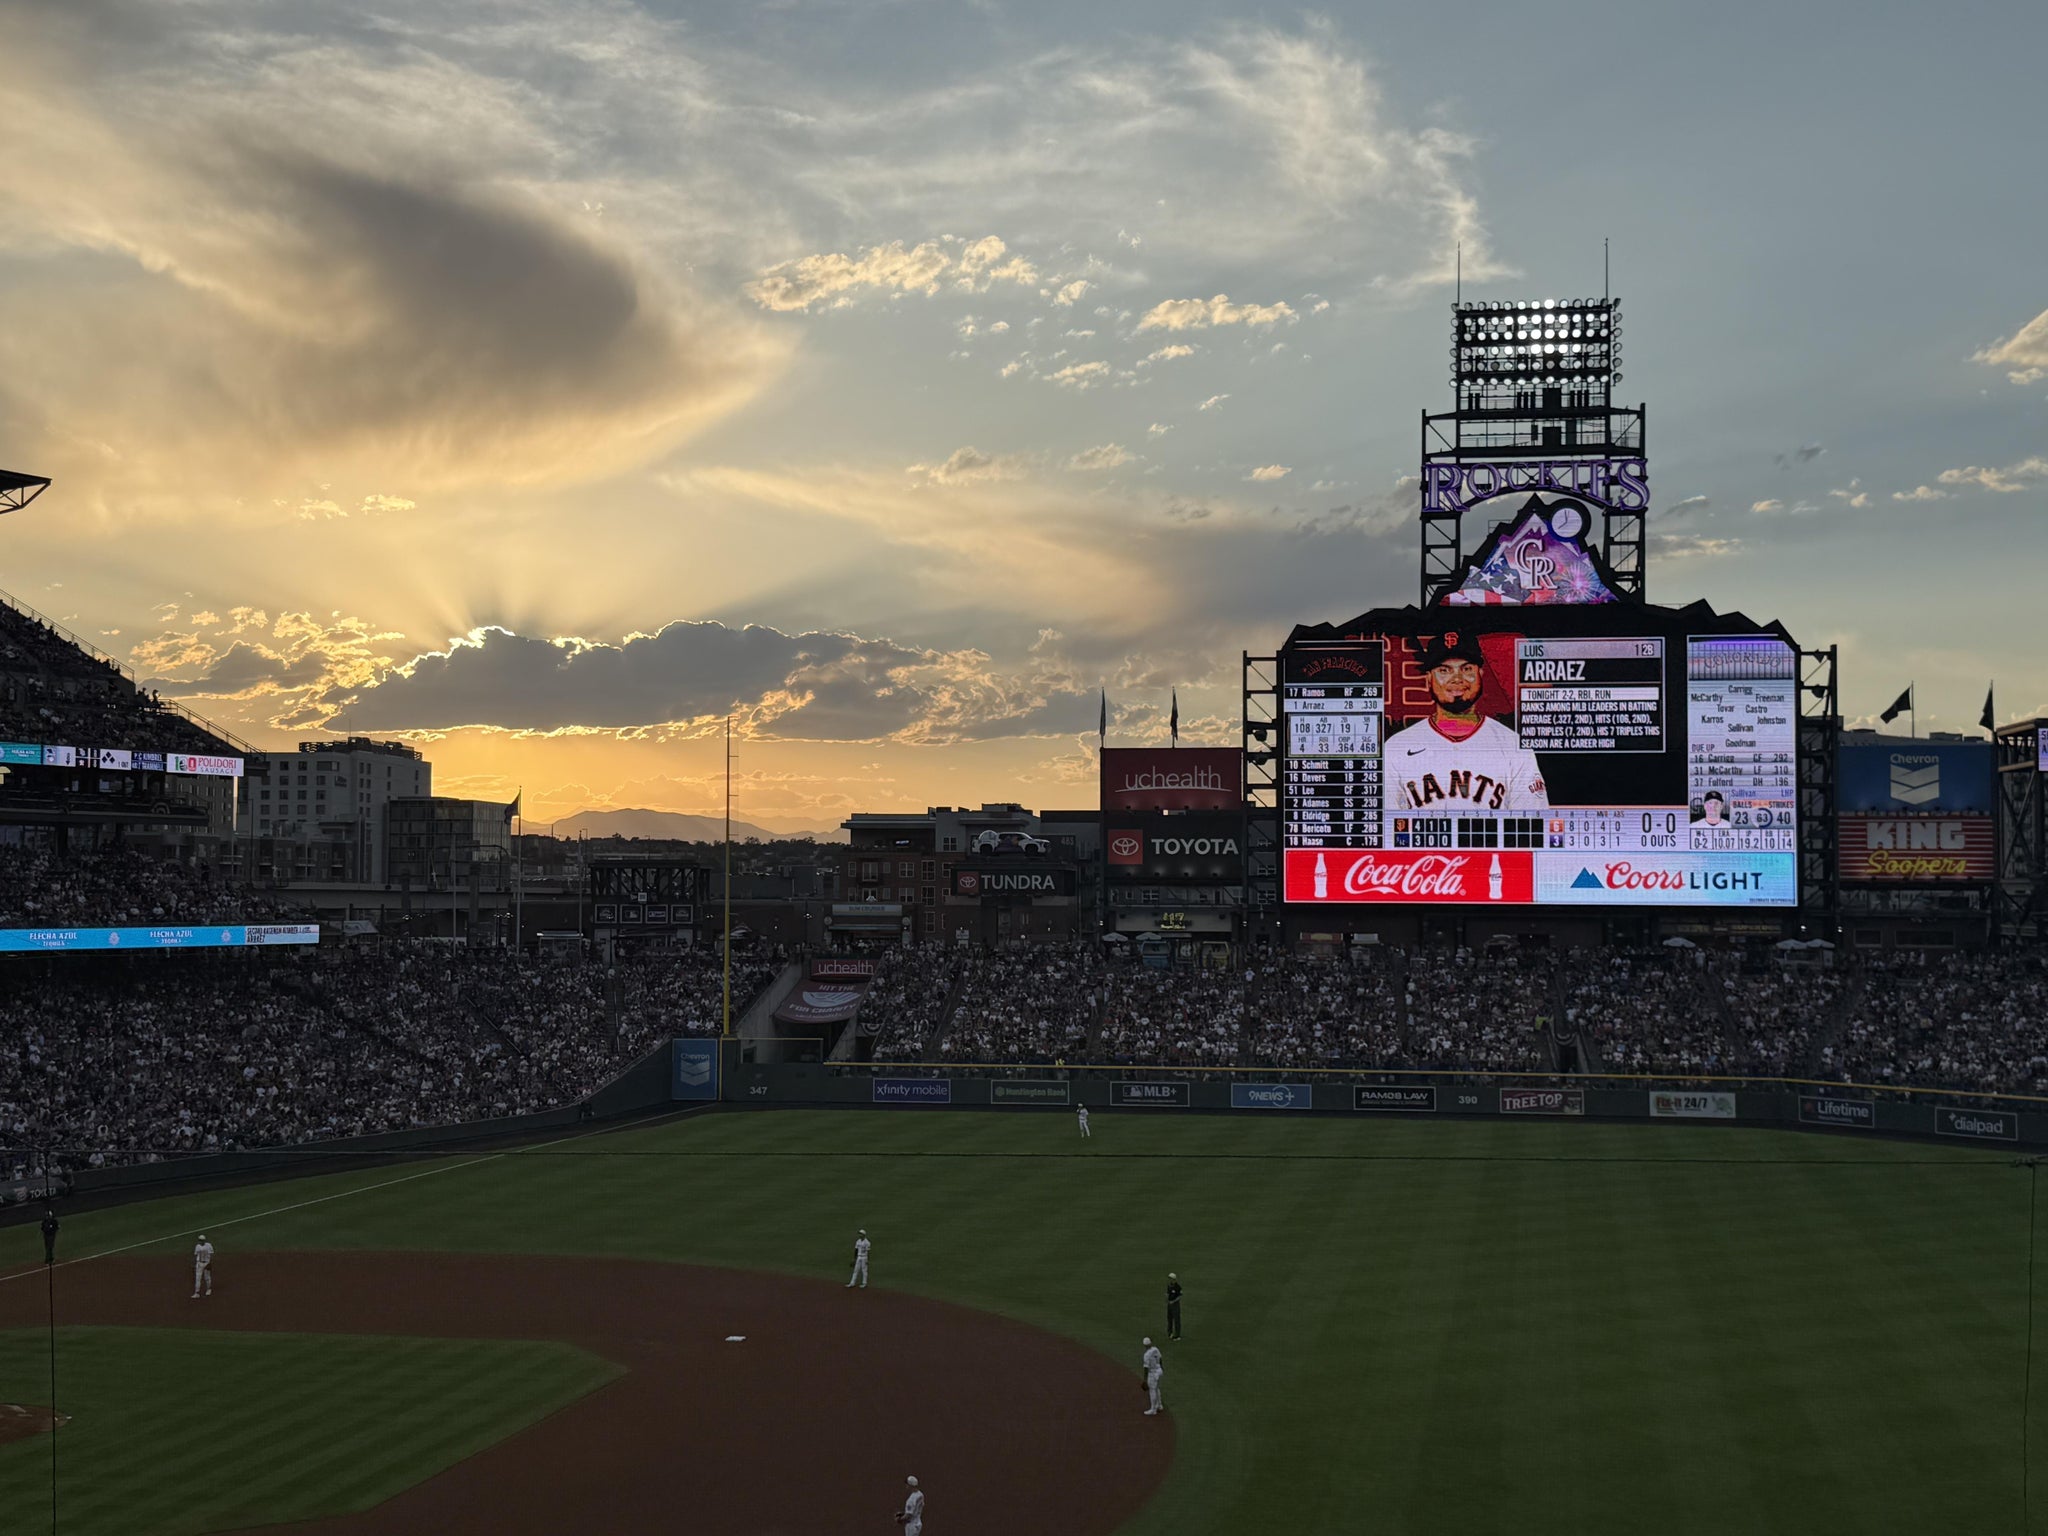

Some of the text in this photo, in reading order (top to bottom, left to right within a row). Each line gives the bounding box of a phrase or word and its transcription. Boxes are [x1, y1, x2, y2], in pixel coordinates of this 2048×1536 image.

[1422, 459, 1651, 512] ROCKIES
[1524, 644, 1653, 657] LUIS 2B
[1524, 660, 1586, 681] ARRAEZ
[1289, 687, 1378, 697] 17 Ramos RF .269
[1527, 690, 1560, 700] TONIGHT
[1562, 690, 1576, 701] 2-2,
[1595, 690, 1611, 699] RUN
[1691, 693, 1784, 703] McCarthy Freeman
[1302, 701, 1378, 710] Arraez 2B .330
[1521, 702, 1657, 712] RANKS AMONG MLB LEADERS IN BATTING
[1717, 704, 1768, 713] Tovar Castro
[1521, 715, 1552, 725] AVERAGE
[1595, 714, 1611, 724] HITS
[1701, 715, 1787, 725] Karros Johnston
[1295, 723, 1351, 733] 108 327 19
[1521, 727, 1536, 737] AND
[1537, 727, 1564, 737] TRIPLES
[1565, 726, 1575, 738] (7,
[1597, 726, 1609, 736] HIS
[1616, 726, 1643, 736] TRIPLES
[1644, 726, 1660, 736] THIS
[1728, 724, 1754, 733] Sullivan
[1299, 743, 1376, 753] 4 33 .364 .468
[1521, 739, 1615, 749] SEASON ARE CAREER HIGH
[1692, 744, 1715, 752] DUE UP
[1725, 738, 1756, 747] Goodman
[198, 757, 237, 769] POLIDORI
[1694, 754, 1703, 763] 16
[1890, 753, 1939, 764] Chevron
[1289, 760, 1298, 769] 10
[1302, 760, 1329, 769] Schmitt
[1344, 760, 1354, 769] 3B
[1694, 767, 1703, 775] 31
[1708, 766, 1743, 775] McCarthy
[1753, 766, 1762, 775] LF
[1125, 765, 1221, 790] uchealth
[1289, 773, 1378, 782] 16 Devers 1B .245
[1752, 777, 1763, 786] DH
[1289, 785, 1378, 795] 51 Lee CF .317
[1407, 770, 1505, 810] IANTS
[1731, 789, 1757, 797] Sullivan
[1302, 798, 1378, 808] Adames SS .230
[1733, 801, 1794, 809] BALLS STRIKES
[1302, 811, 1330, 822] Eldridge
[1344, 811, 1354, 820] DH
[1735, 811, 1791, 824] 23 63 40
[1302, 823, 1332, 833] Bericoto
[1344, 823, 1354, 833] LF
[1302, 837, 1324, 846] Haase
[1346, 837, 1352, 846] C
[1361, 837, 1378, 846] .179
[1641, 835, 1676, 847] 0 OUTS
[1867, 822, 1965, 850] KING
[1151, 838, 1239, 855] TOYOTA
[1694, 838, 1792, 849] 0-2 10.07 19.2 10 14
[1864, 850, 1968, 880] Soopers
[1344, 855, 1471, 895] Coca-Cola
[1605, 861, 1763, 890] Coors LIGHT
[981, 874, 1055, 890] TUNDRA
[818, 960, 874, 975] uchealth
[749, 1086, 768, 1095] 347
[876, 1084, 948, 1096] xfinity mobile
[1005, 1087, 1066, 1098] Huntington Bank
[1144, 1086, 1177, 1097] MLB+
[1361, 1092, 1428, 1100] RAMOS LAW
[1458, 1095, 1478, 1104] 390
[1684, 1097, 1708, 1108] 24/7
[1817, 1101, 1869, 1118] Lifetime
[1954, 1117, 2003, 1134] dialpad
